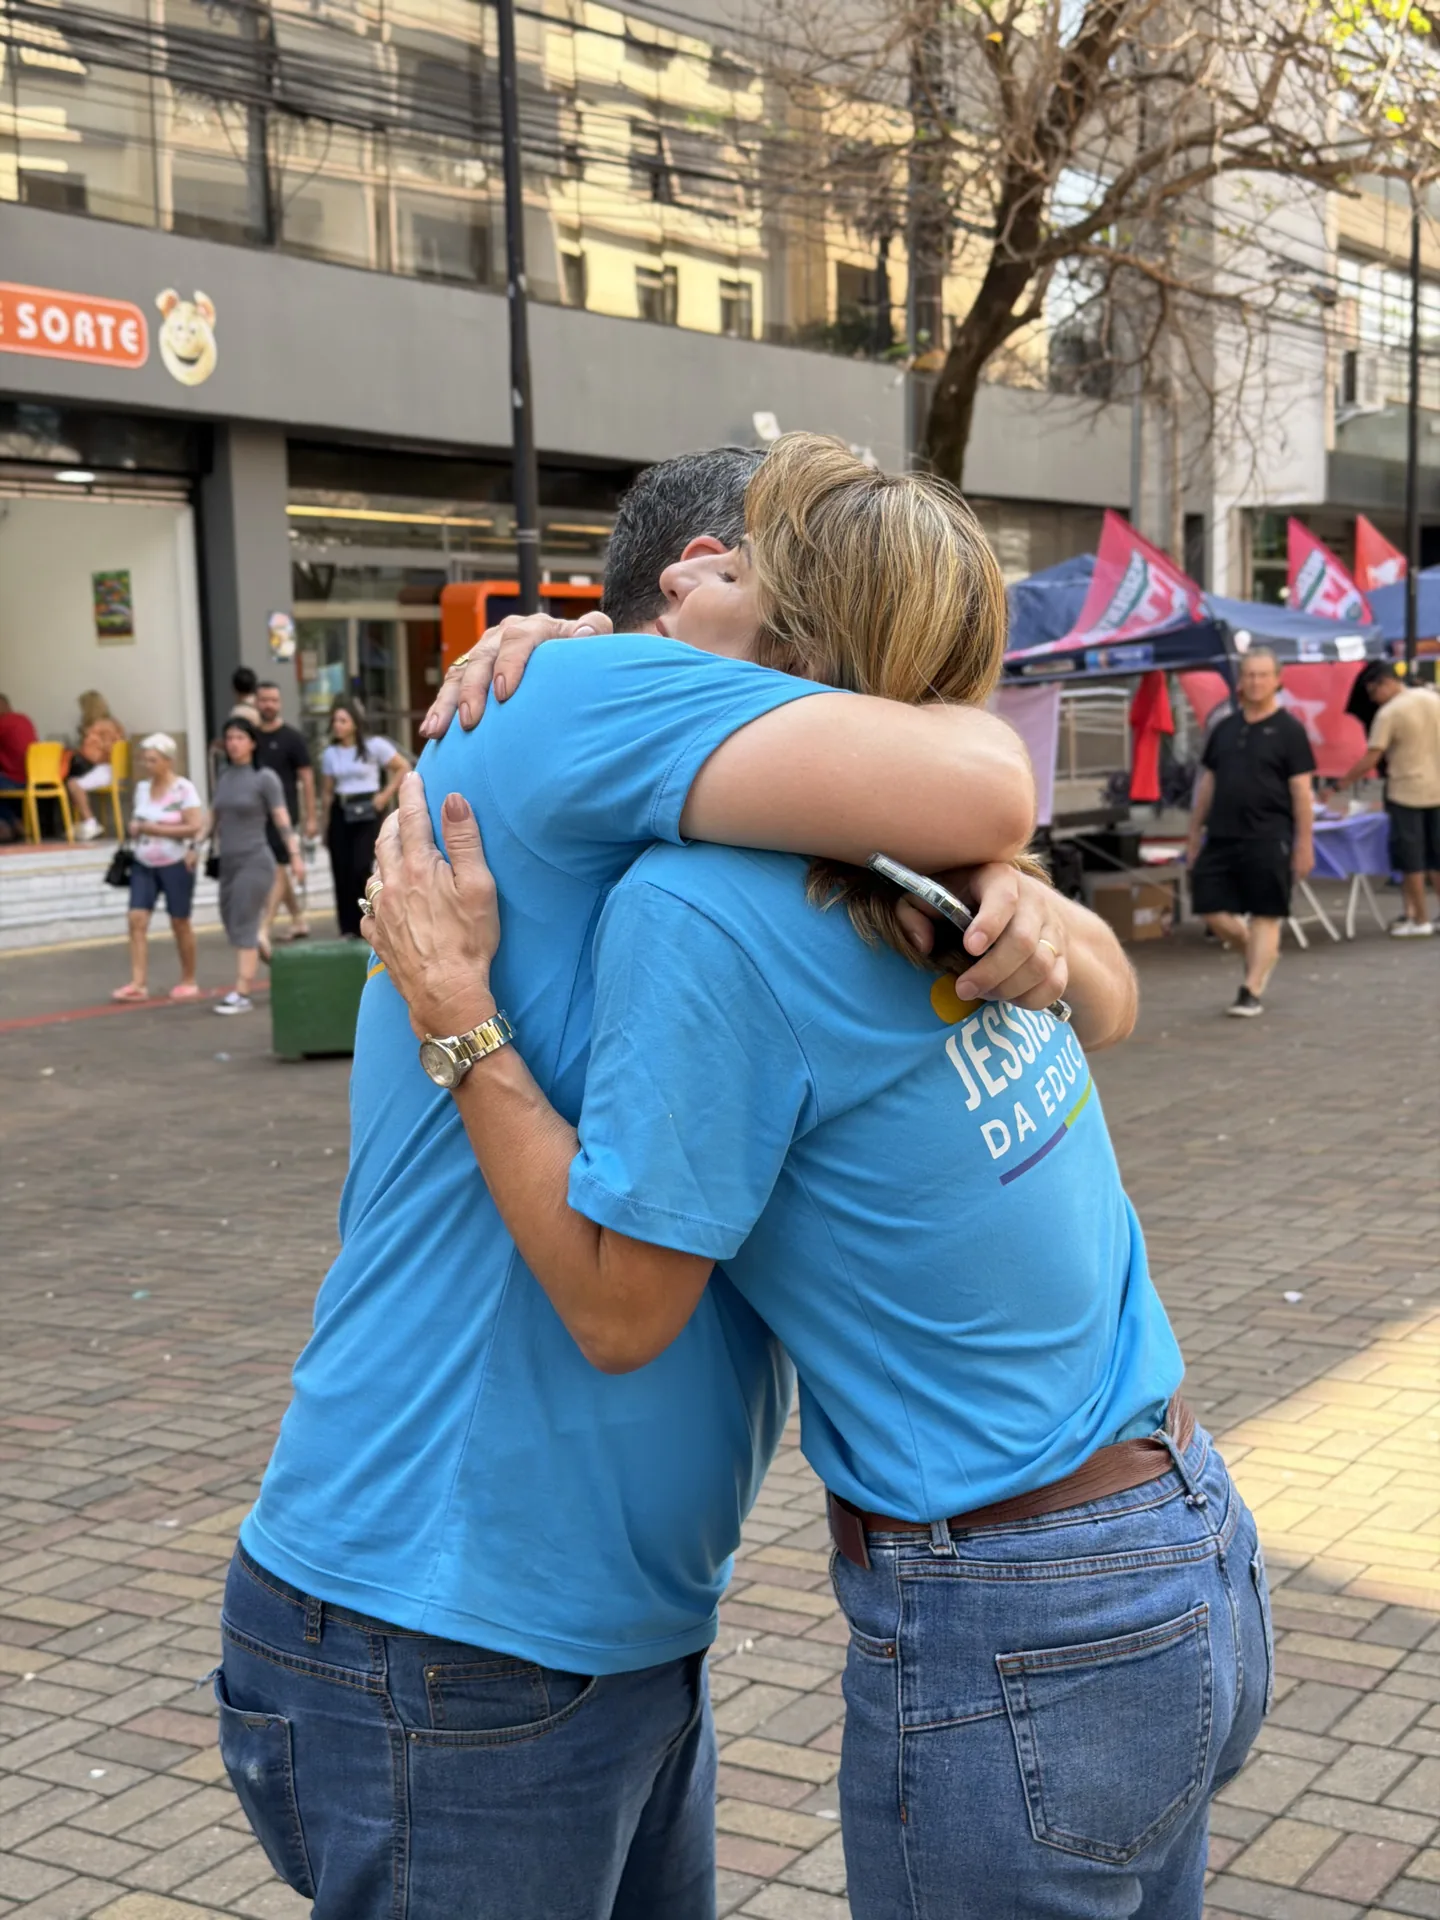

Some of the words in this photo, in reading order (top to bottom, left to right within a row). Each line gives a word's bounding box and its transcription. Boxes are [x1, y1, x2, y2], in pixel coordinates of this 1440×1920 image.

[16, 302, 140, 354] SORTE
[945, 1000, 1056, 1111] JESSIC
[980, 1101, 1037, 1160] DA
